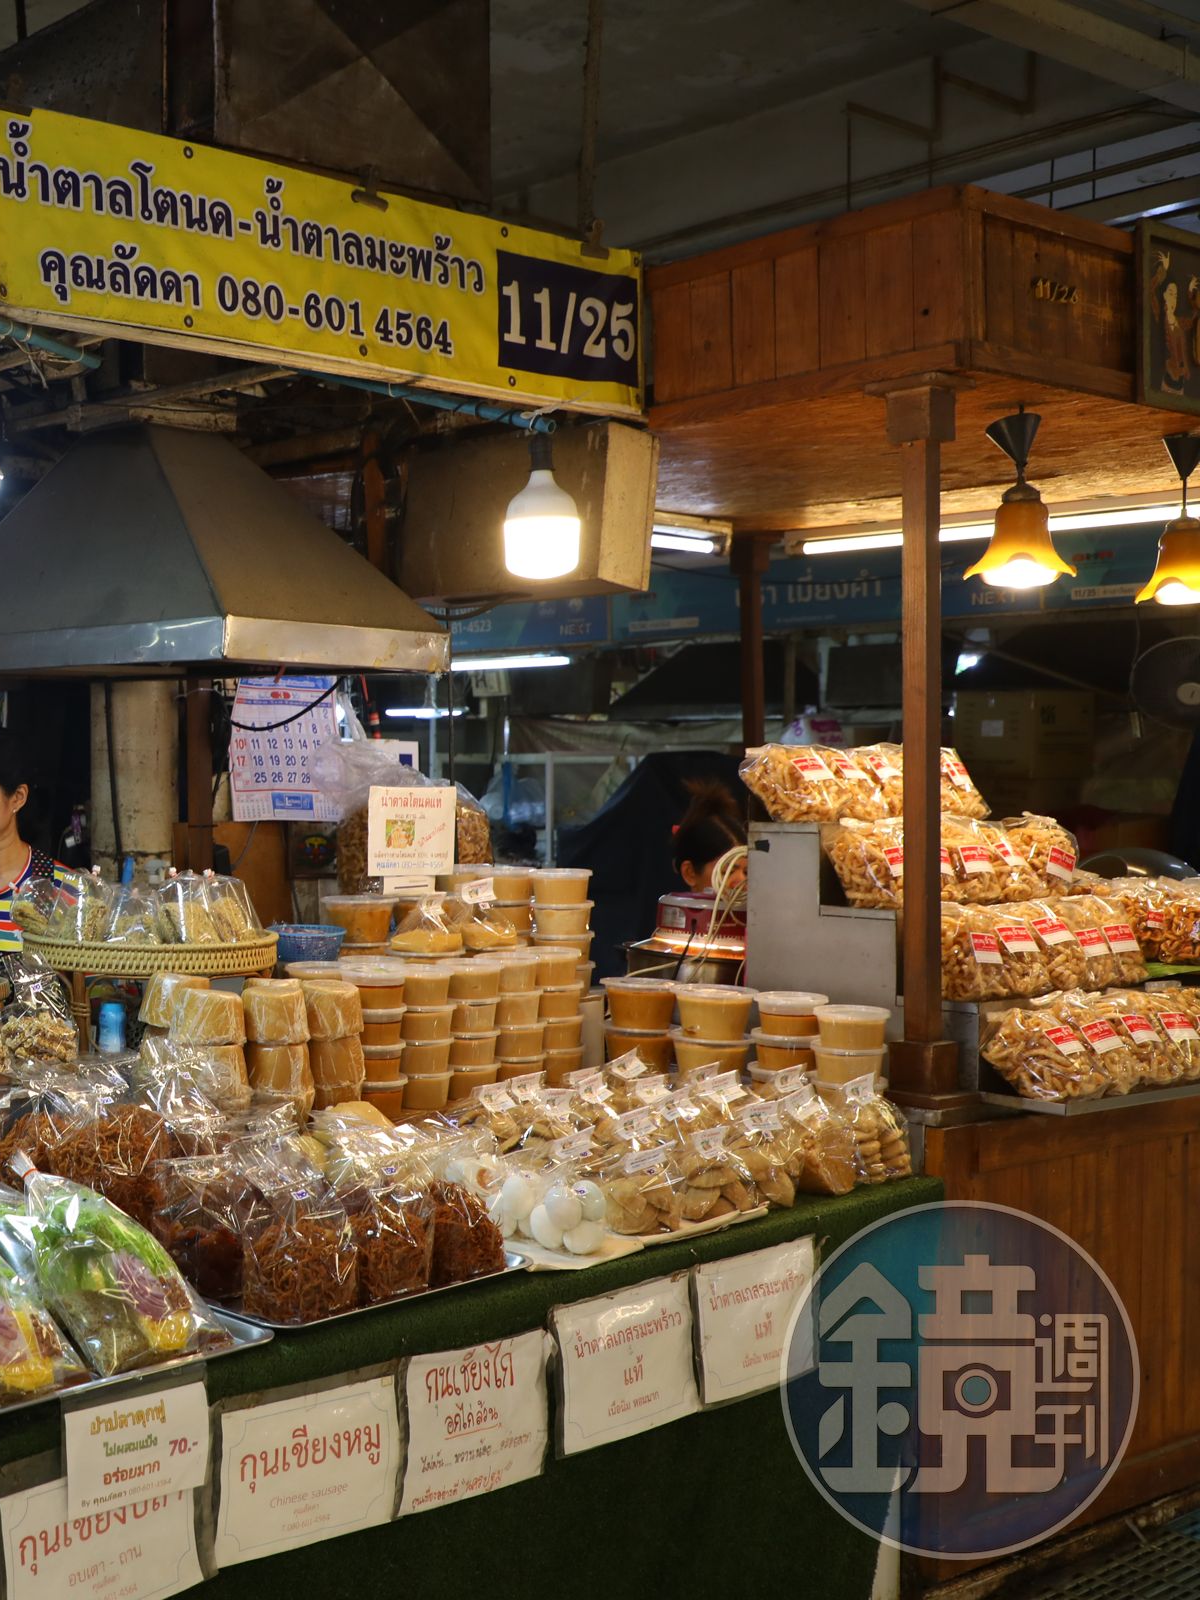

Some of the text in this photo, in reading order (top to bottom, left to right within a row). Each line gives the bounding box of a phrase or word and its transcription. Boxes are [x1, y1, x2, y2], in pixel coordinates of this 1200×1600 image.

[39, 241, 453, 357] คุณลัดดา 080-601 4564
[501, 279, 637, 360] 11/25
[559, 621, 593, 637] NEXT
[283, 722, 290, 733] 6
[297, 722, 303, 733] 7
[311, 723, 318, 734] 8
[251, 738, 260, 749] 11
[267, 738, 278, 749] 12
[284, 738, 294, 750] 13
[298, 739, 308, 750] 14
[236, 756, 246, 767] 17
[253, 755, 264, 767] 18
[270, 755, 280, 767] 19
[285, 755, 296, 767] 20
[254, 772, 267, 783] 25
[271, 772, 284, 783] 26
[287, 772, 297, 783] 27
[301, 773, 311, 783] 28
[623, 1354, 645, 1386] แท้
[238, 1421, 382, 1493] กุนเชียงหมู
[102, 1459, 161, 1486] อร่อยมาก
[311, 1483, 349, 1500] sausage
